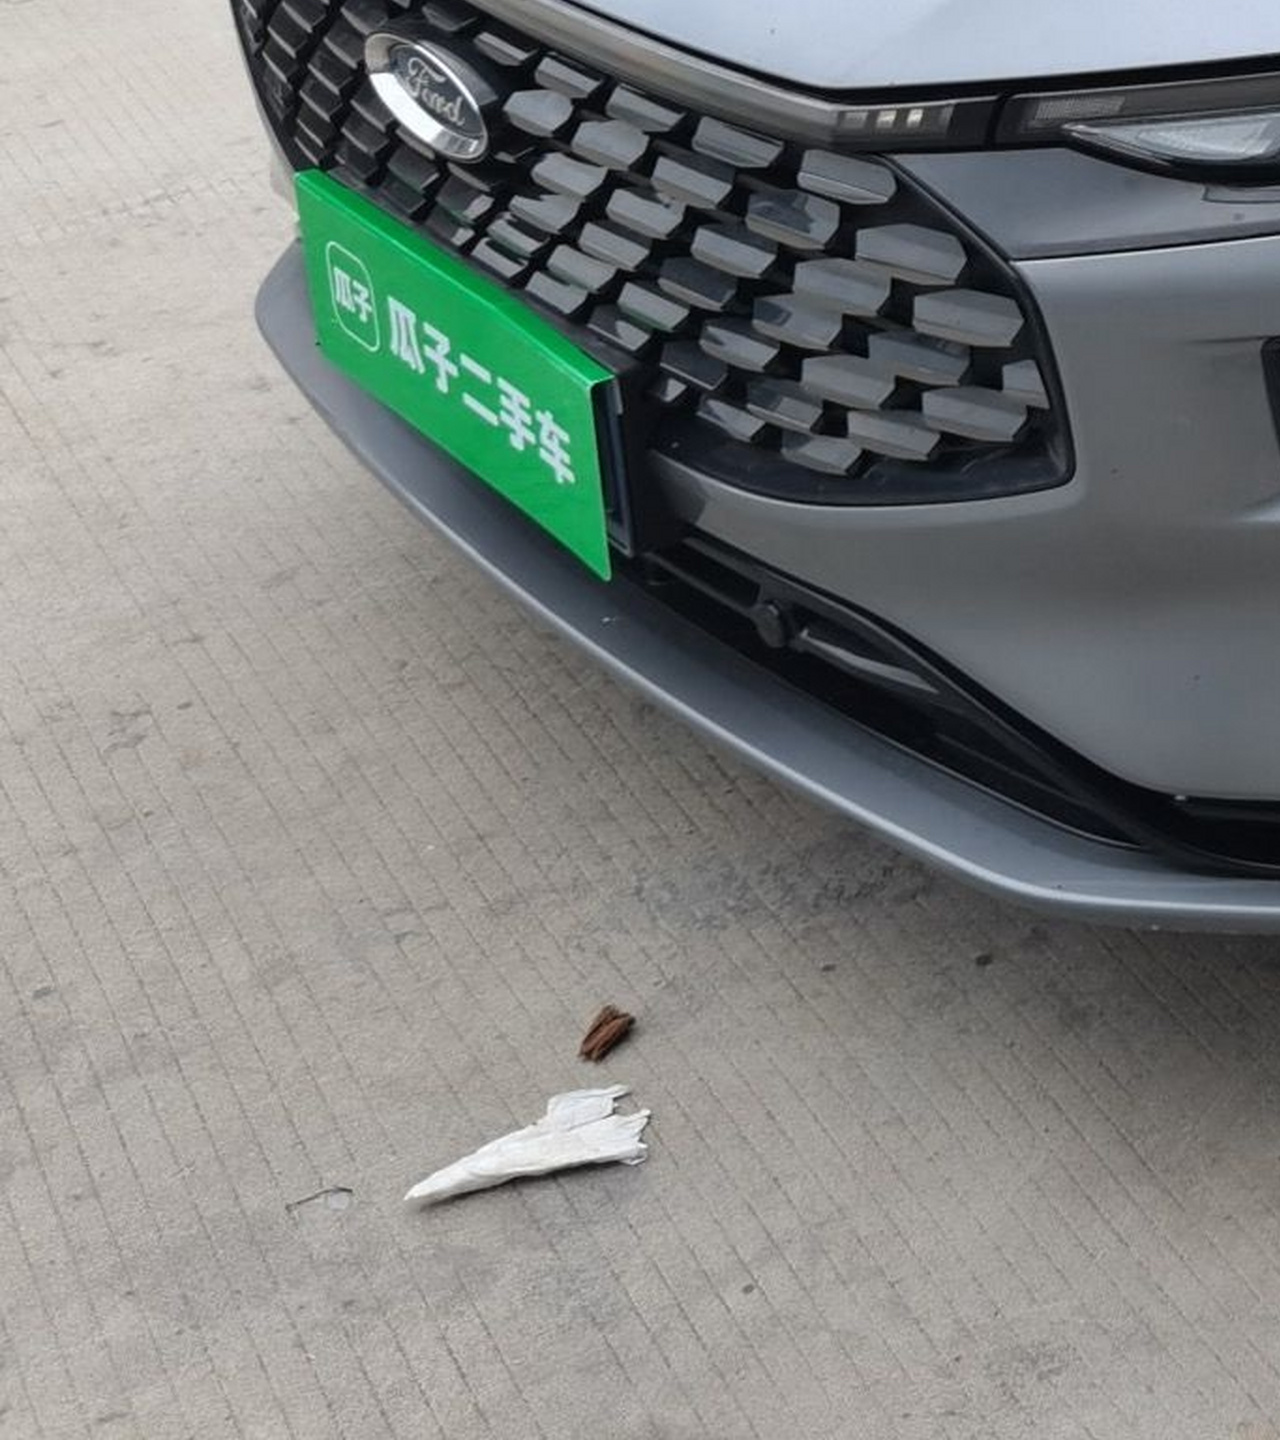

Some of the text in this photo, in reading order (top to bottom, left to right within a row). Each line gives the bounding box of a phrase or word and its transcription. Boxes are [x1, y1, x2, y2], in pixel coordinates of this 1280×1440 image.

[408, 57, 466, 127] Ford
[333, 266, 374, 323] 瓜子
[387, 293, 576, 485] 瓜子二手车
